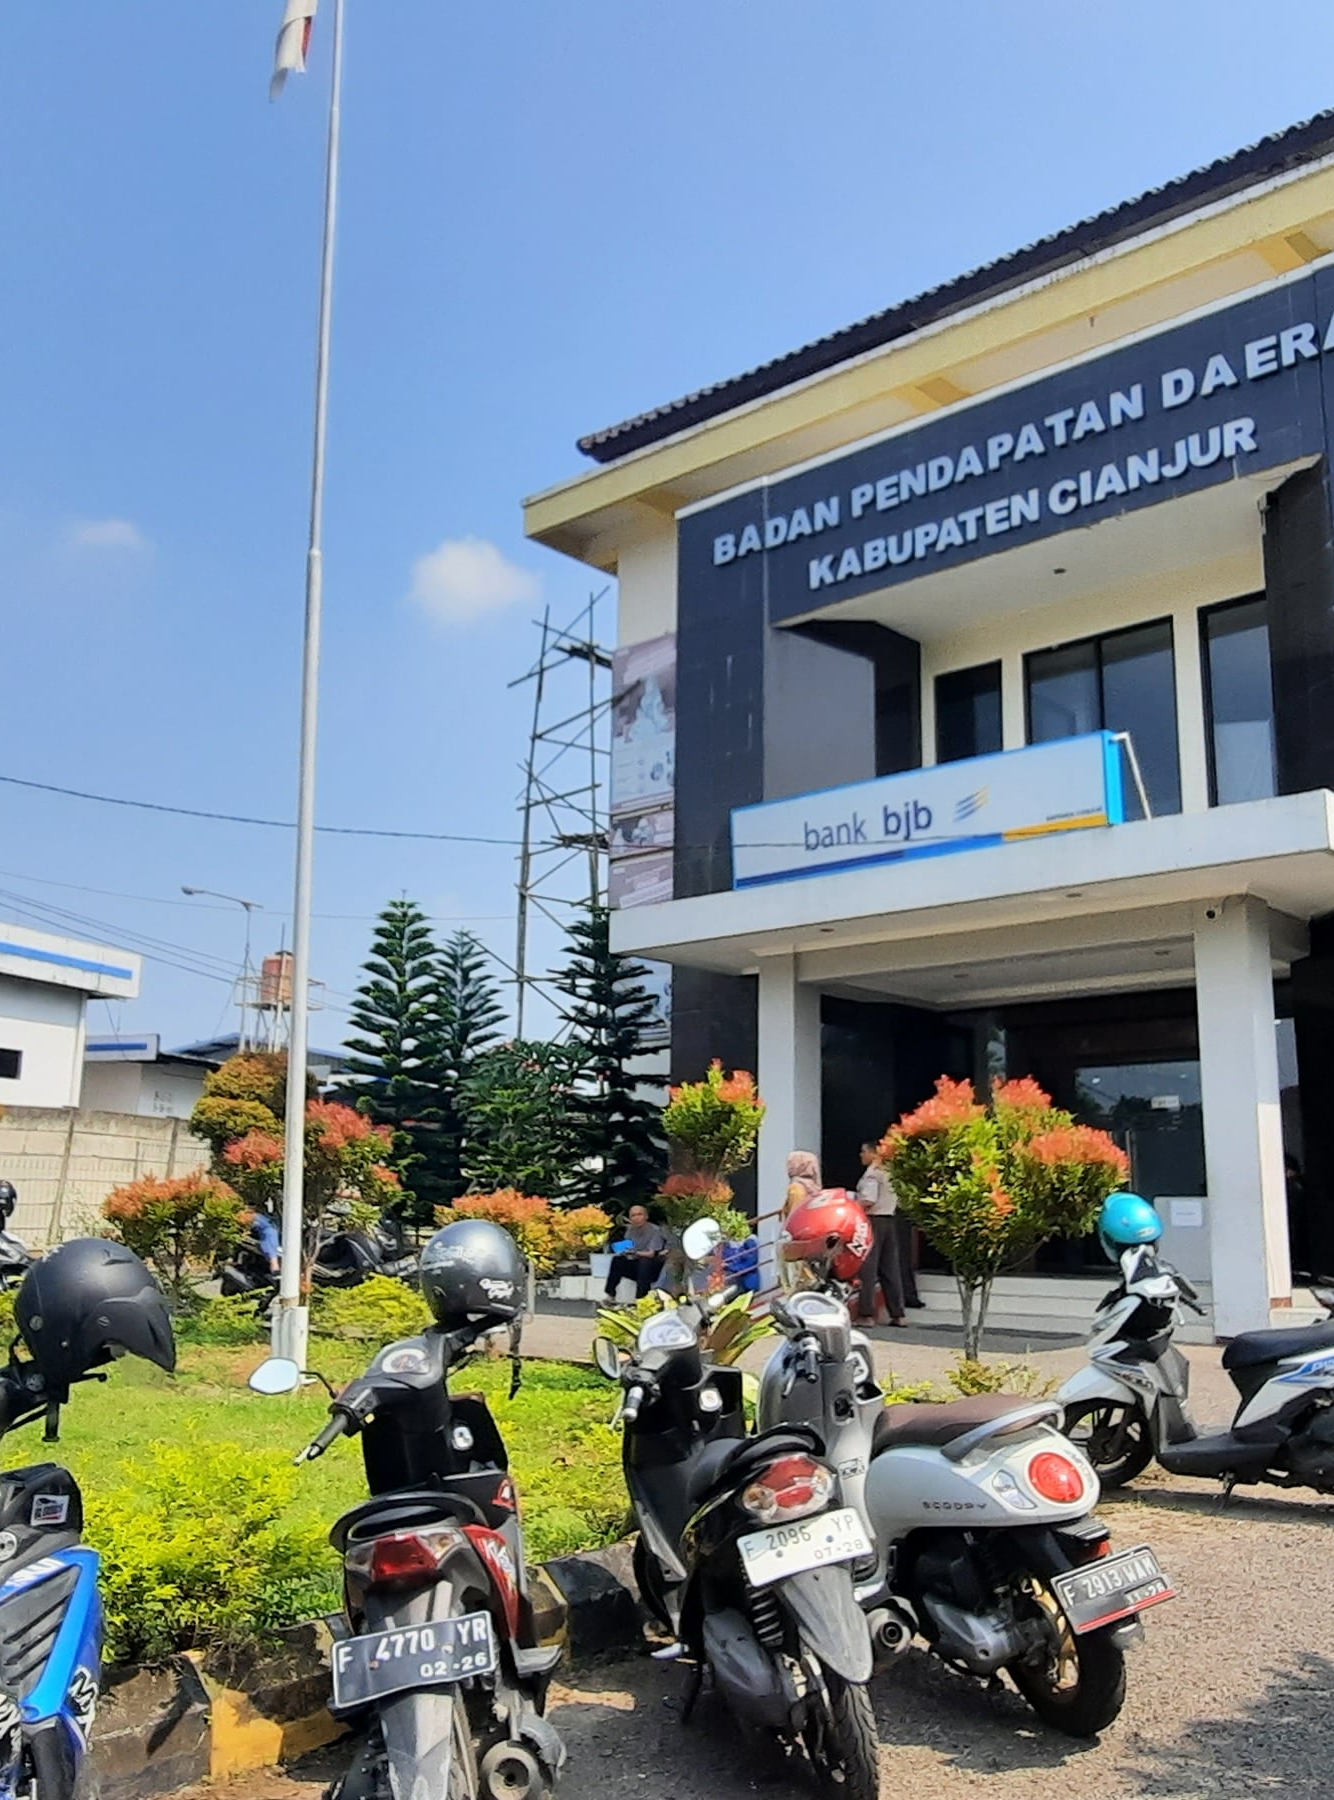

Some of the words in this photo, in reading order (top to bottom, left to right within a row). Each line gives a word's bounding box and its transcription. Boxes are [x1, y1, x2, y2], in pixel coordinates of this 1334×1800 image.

[713, 495, 840, 566] BADAN
[851, 383, 1144, 519] PENDAPATAN
[808, 488, 1040, 590] KABUPATEN
[1047, 416, 1258, 516] CIANJUR
[804, 811, 867, 851] bank
[883, 799, 933, 841] bjb
[743, 1540, 754, 1559] F
[765, 1525, 811, 1551] 2096
[830, 1514, 853, 1533] YP
[1063, 1585, 1076, 1608] F
[1082, 1569, 1123, 1600] 2913
[338, 1646, 354, 1674] F
[375, 1628, 435, 1662] 4770
[456, 1617, 487, 1646] YR
